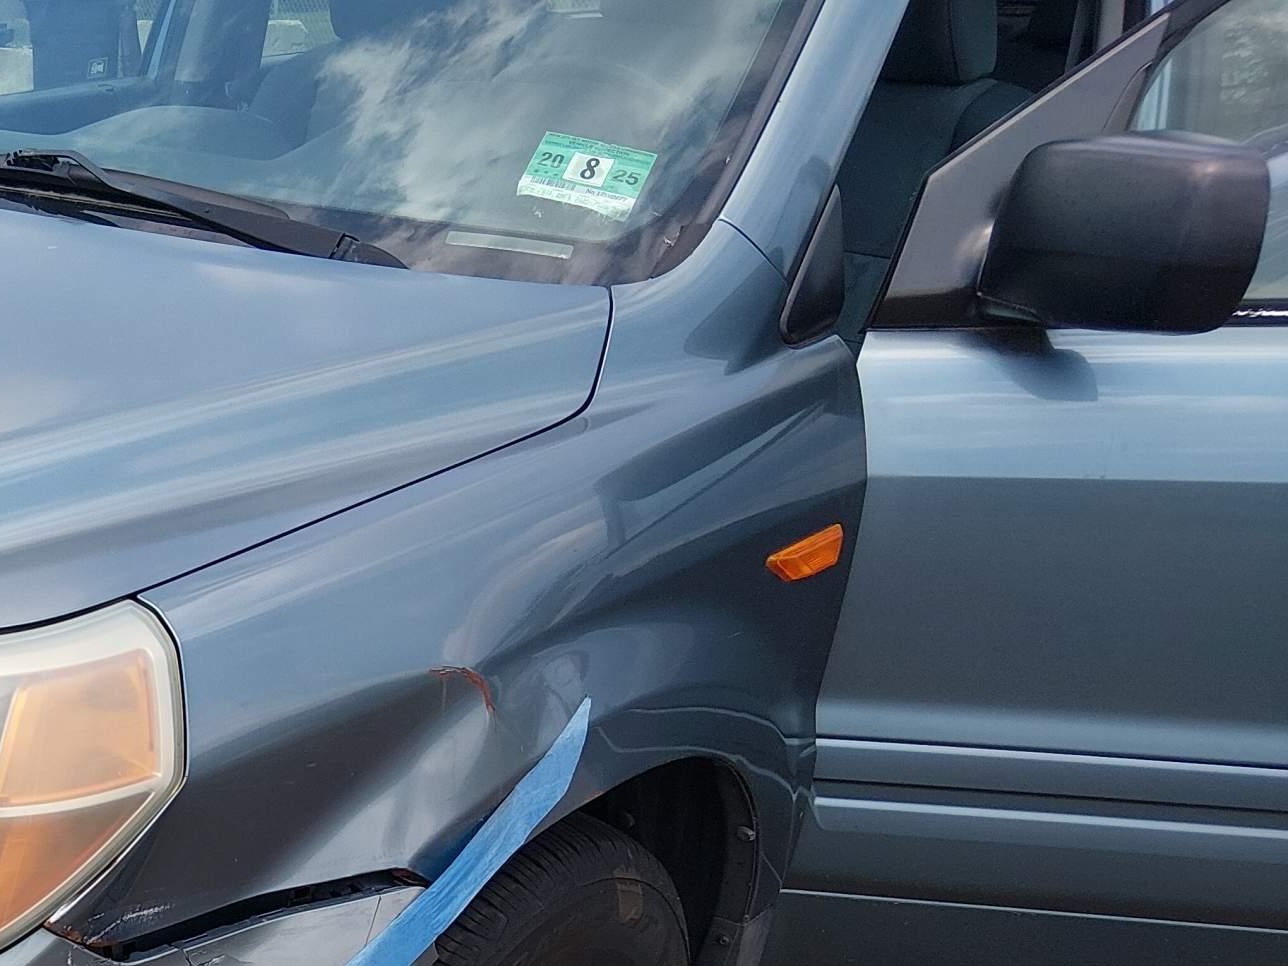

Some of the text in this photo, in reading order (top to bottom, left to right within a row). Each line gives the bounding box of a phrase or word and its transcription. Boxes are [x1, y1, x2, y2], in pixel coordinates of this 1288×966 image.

[537, 151, 565, 168] 20
[580, 157, 600, 179] 8
[613, 169, 640, 185] 25
